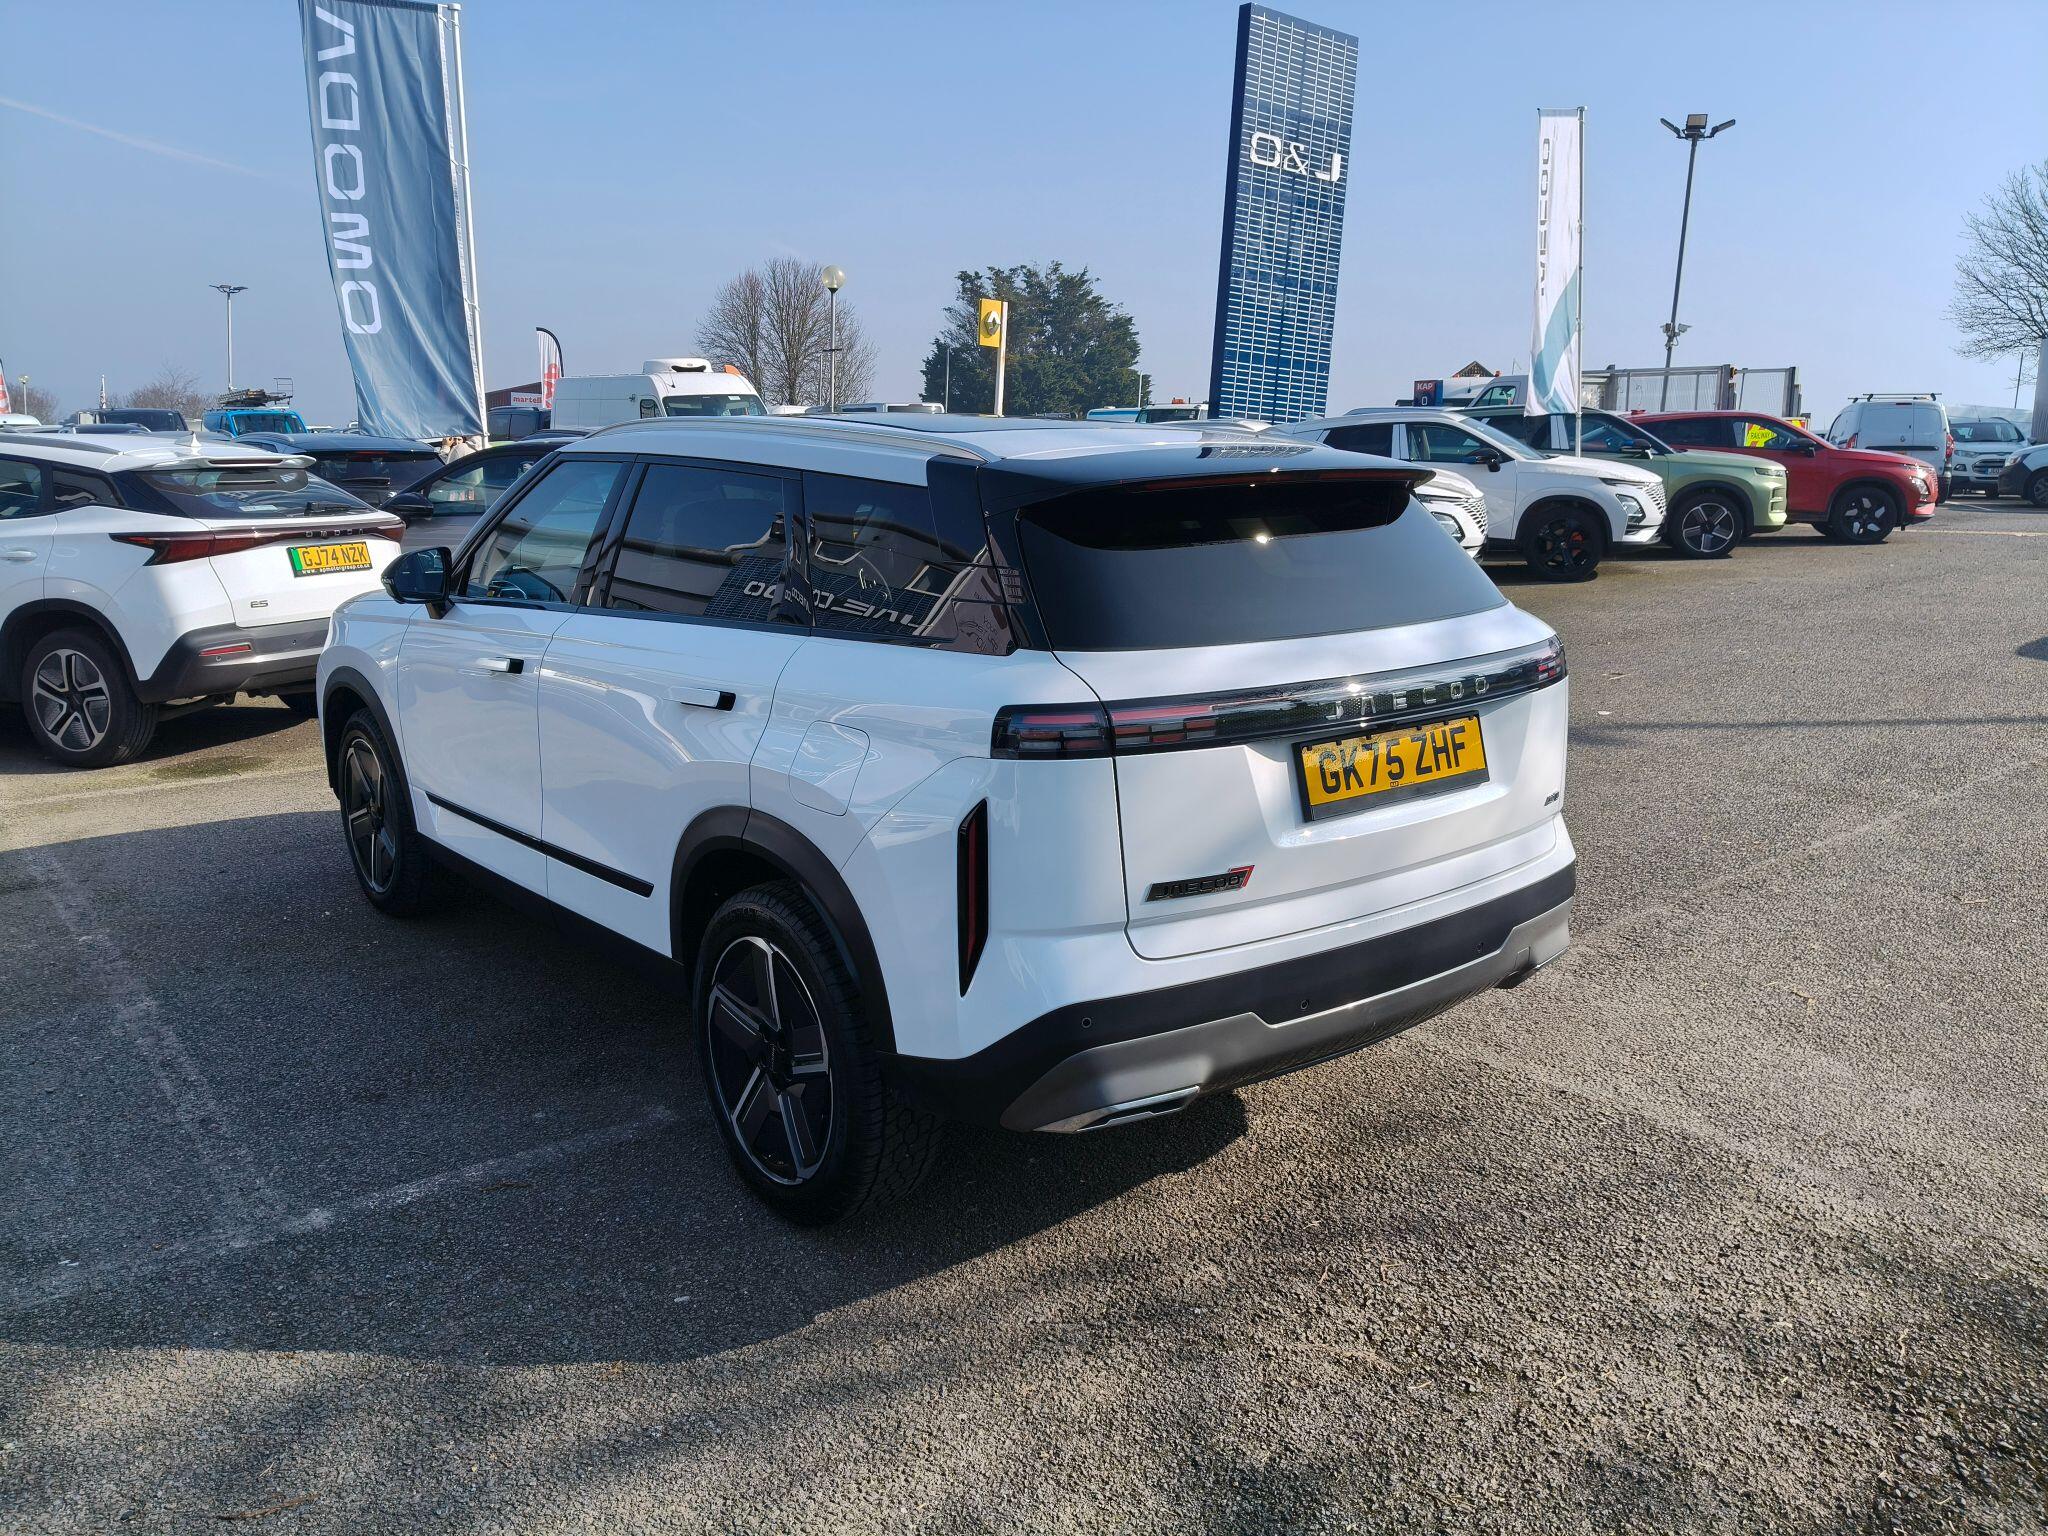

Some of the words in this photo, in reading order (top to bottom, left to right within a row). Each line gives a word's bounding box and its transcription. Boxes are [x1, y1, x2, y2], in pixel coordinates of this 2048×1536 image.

[302, 548, 340, 567] GJ74
[341, 546, 368, 564] NZK
[1325, 677, 1489, 720] JAECOO
[1319, 737, 1405, 795] GK75
[1411, 726, 1466, 776] ZHF
